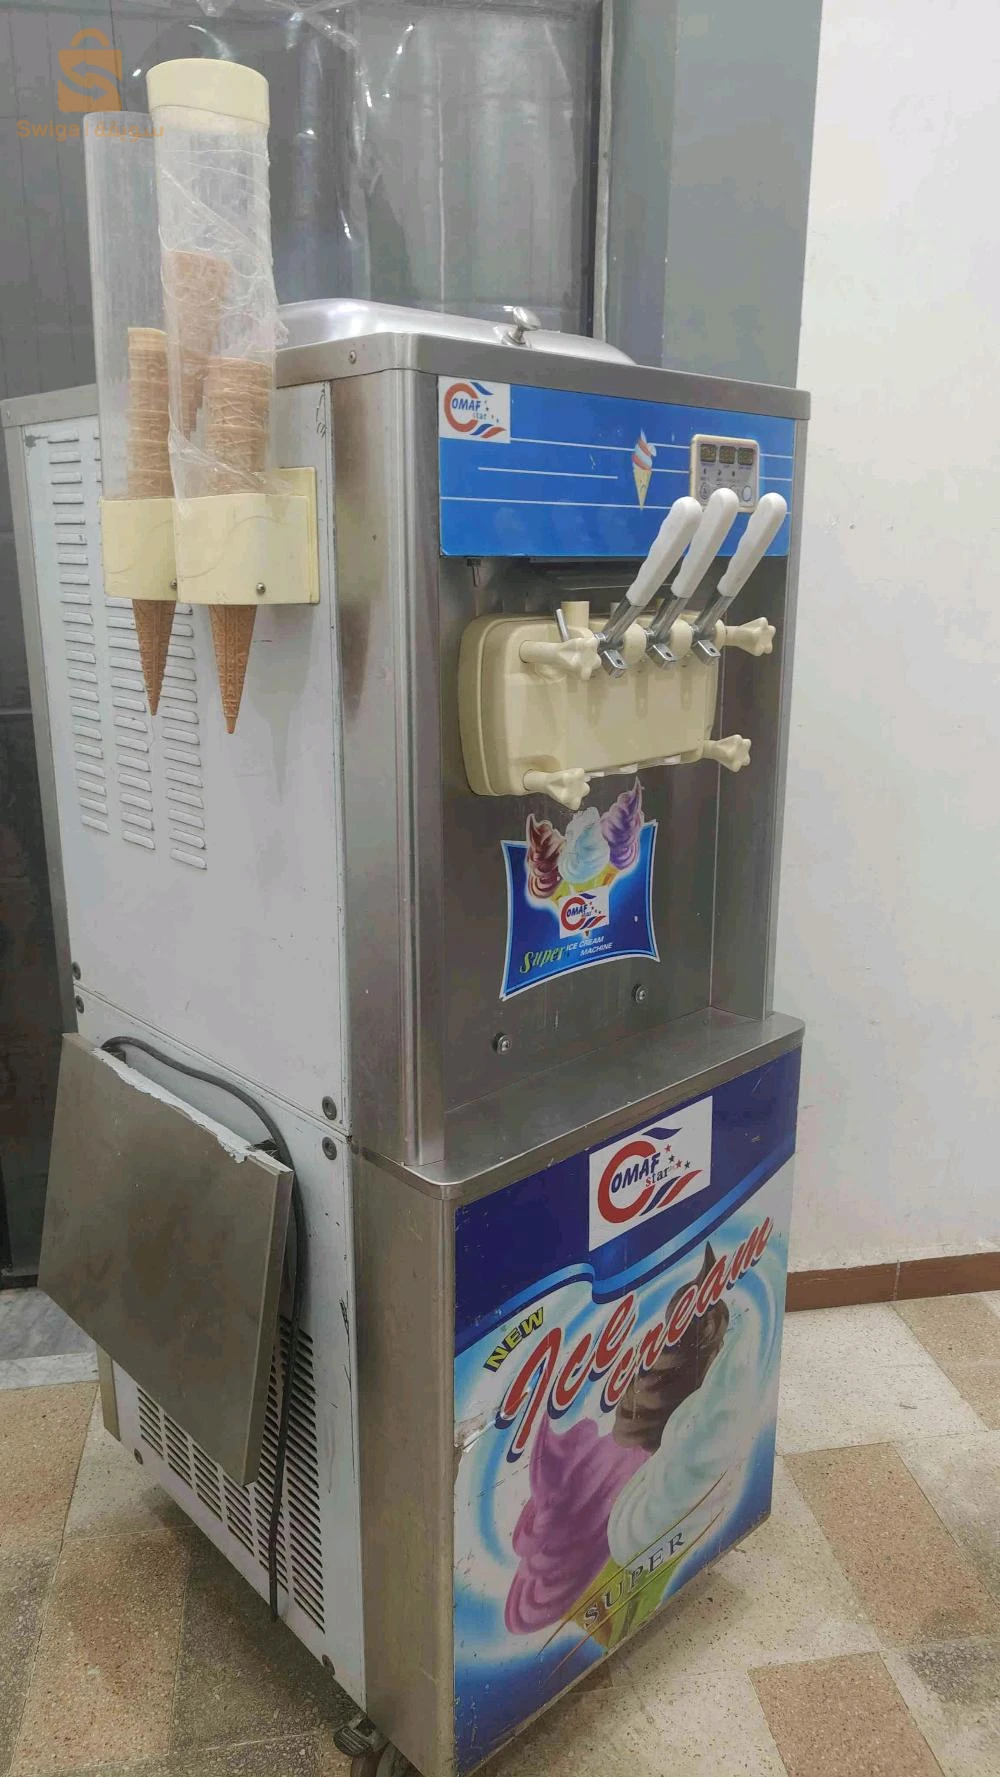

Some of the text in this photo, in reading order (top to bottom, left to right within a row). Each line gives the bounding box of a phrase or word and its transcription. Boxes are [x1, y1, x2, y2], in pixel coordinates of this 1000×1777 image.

[566, 936, 604, 951] ICE CREAM
[580, 943, 613, 956] MACHINE
[520, 946, 566, 974] Super
[645, 1167, 669, 1187] star
[483, 1306, 544, 1374] NEW
[495, 1290, 638, 1463] Ice
[584, 1532, 685, 1629] SUPER
